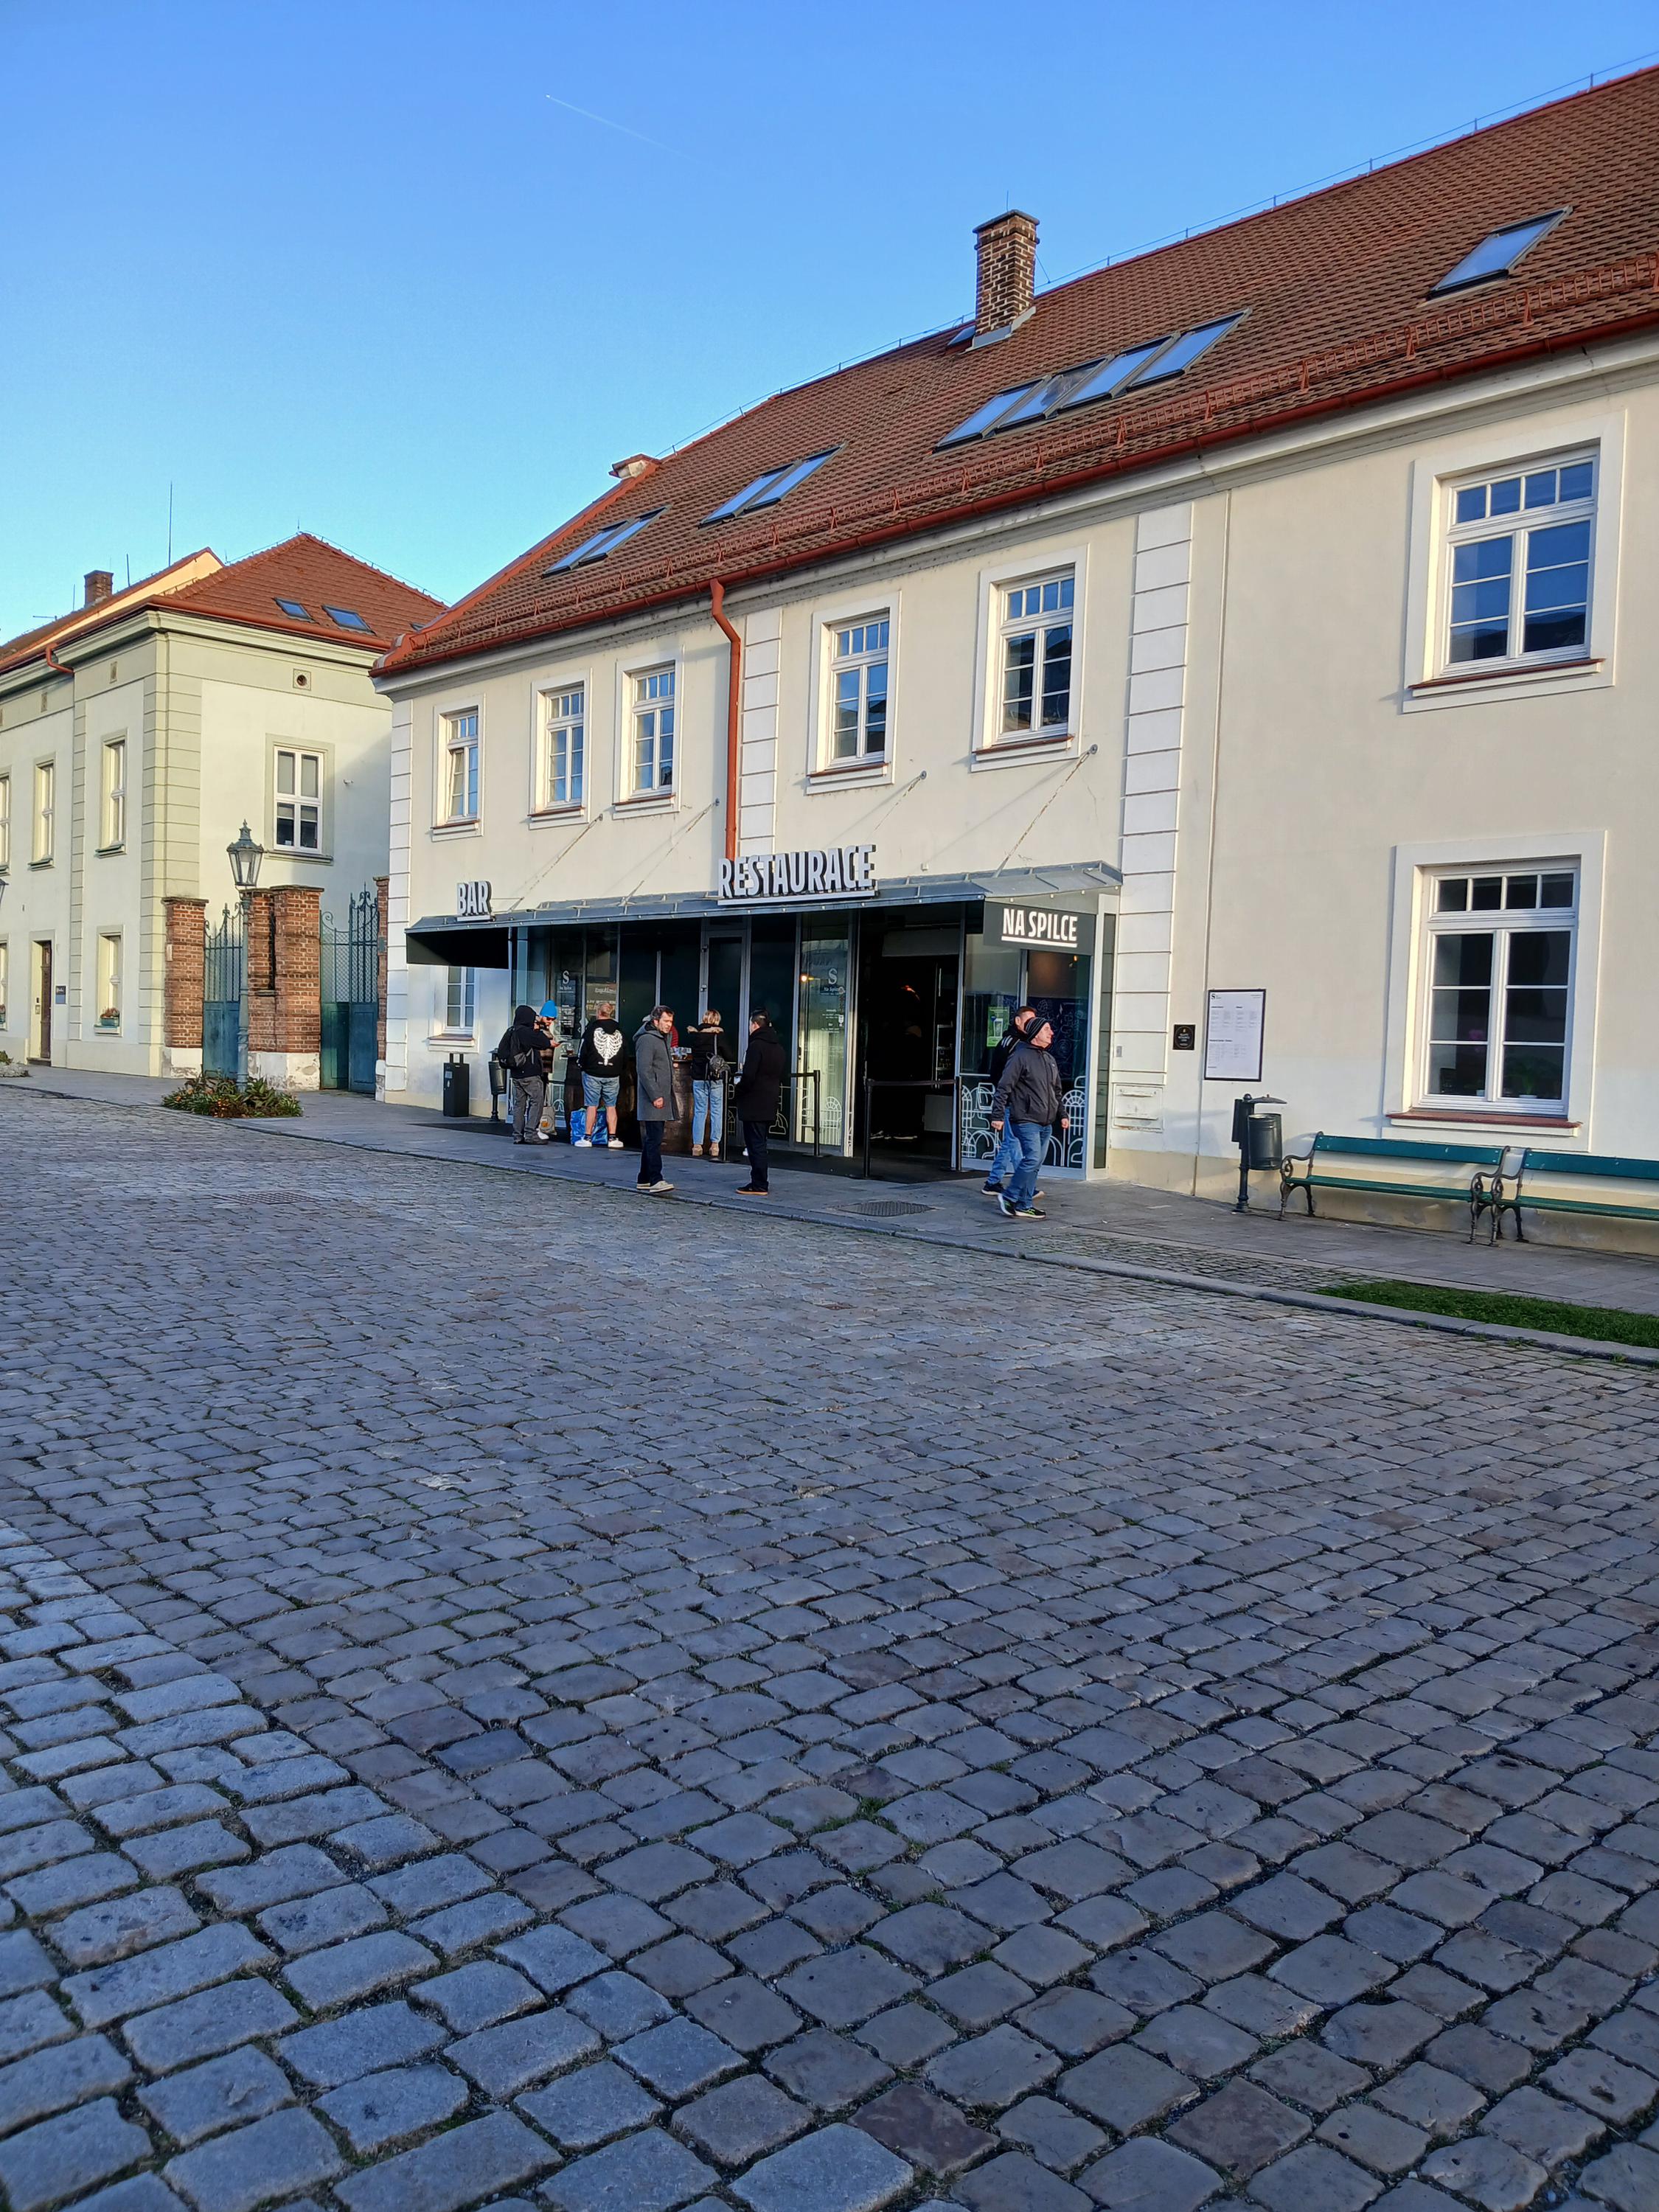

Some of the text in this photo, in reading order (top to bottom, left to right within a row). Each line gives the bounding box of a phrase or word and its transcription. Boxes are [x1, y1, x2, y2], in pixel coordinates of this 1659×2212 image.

[718, 845, 876, 898] RESTAURACE
[457, 881, 490, 915] BAR
[1003, 908, 1078, 942] NA SPILCE
[563, 970, 570, 984] S
[828, 967, 838, 984] S
